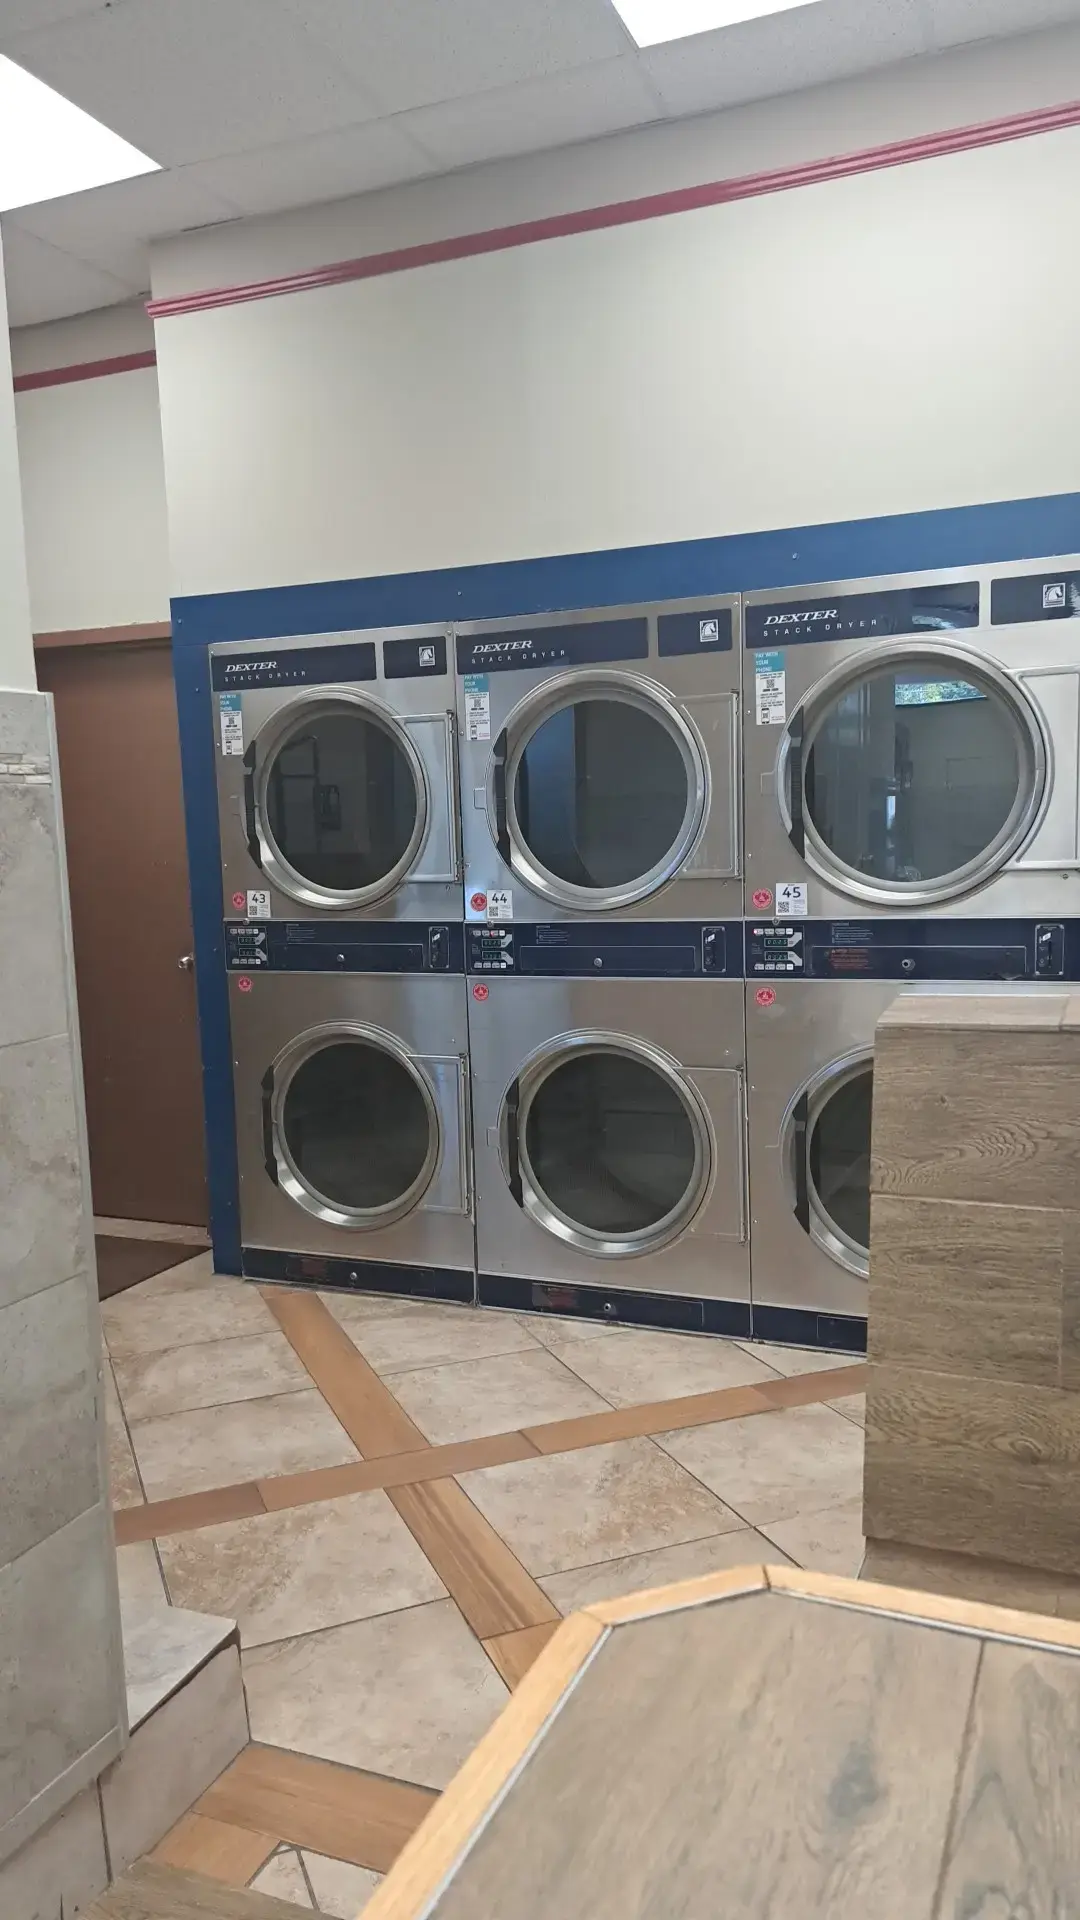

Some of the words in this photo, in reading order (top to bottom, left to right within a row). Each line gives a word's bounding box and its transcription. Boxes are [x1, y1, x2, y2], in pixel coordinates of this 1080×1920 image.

[764, 609, 837, 625] DEXTER
[763, 626, 812, 637] STACK
[825, 619, 877, 631] DRYER
[472, 640, 533, 654] DEXTER
[471, 655, 512, 664] STACK
[522, 650, 565, 660] DRYER
[225, 661, 277, 673] DEXTER
[224, 674, 260, 682] STACK
[268, 671, 306, 679] DRYER
[252, 893, 265, 903] 43
[491, 893, 507, 903] 44
[782, 887, 801, 898] 45
